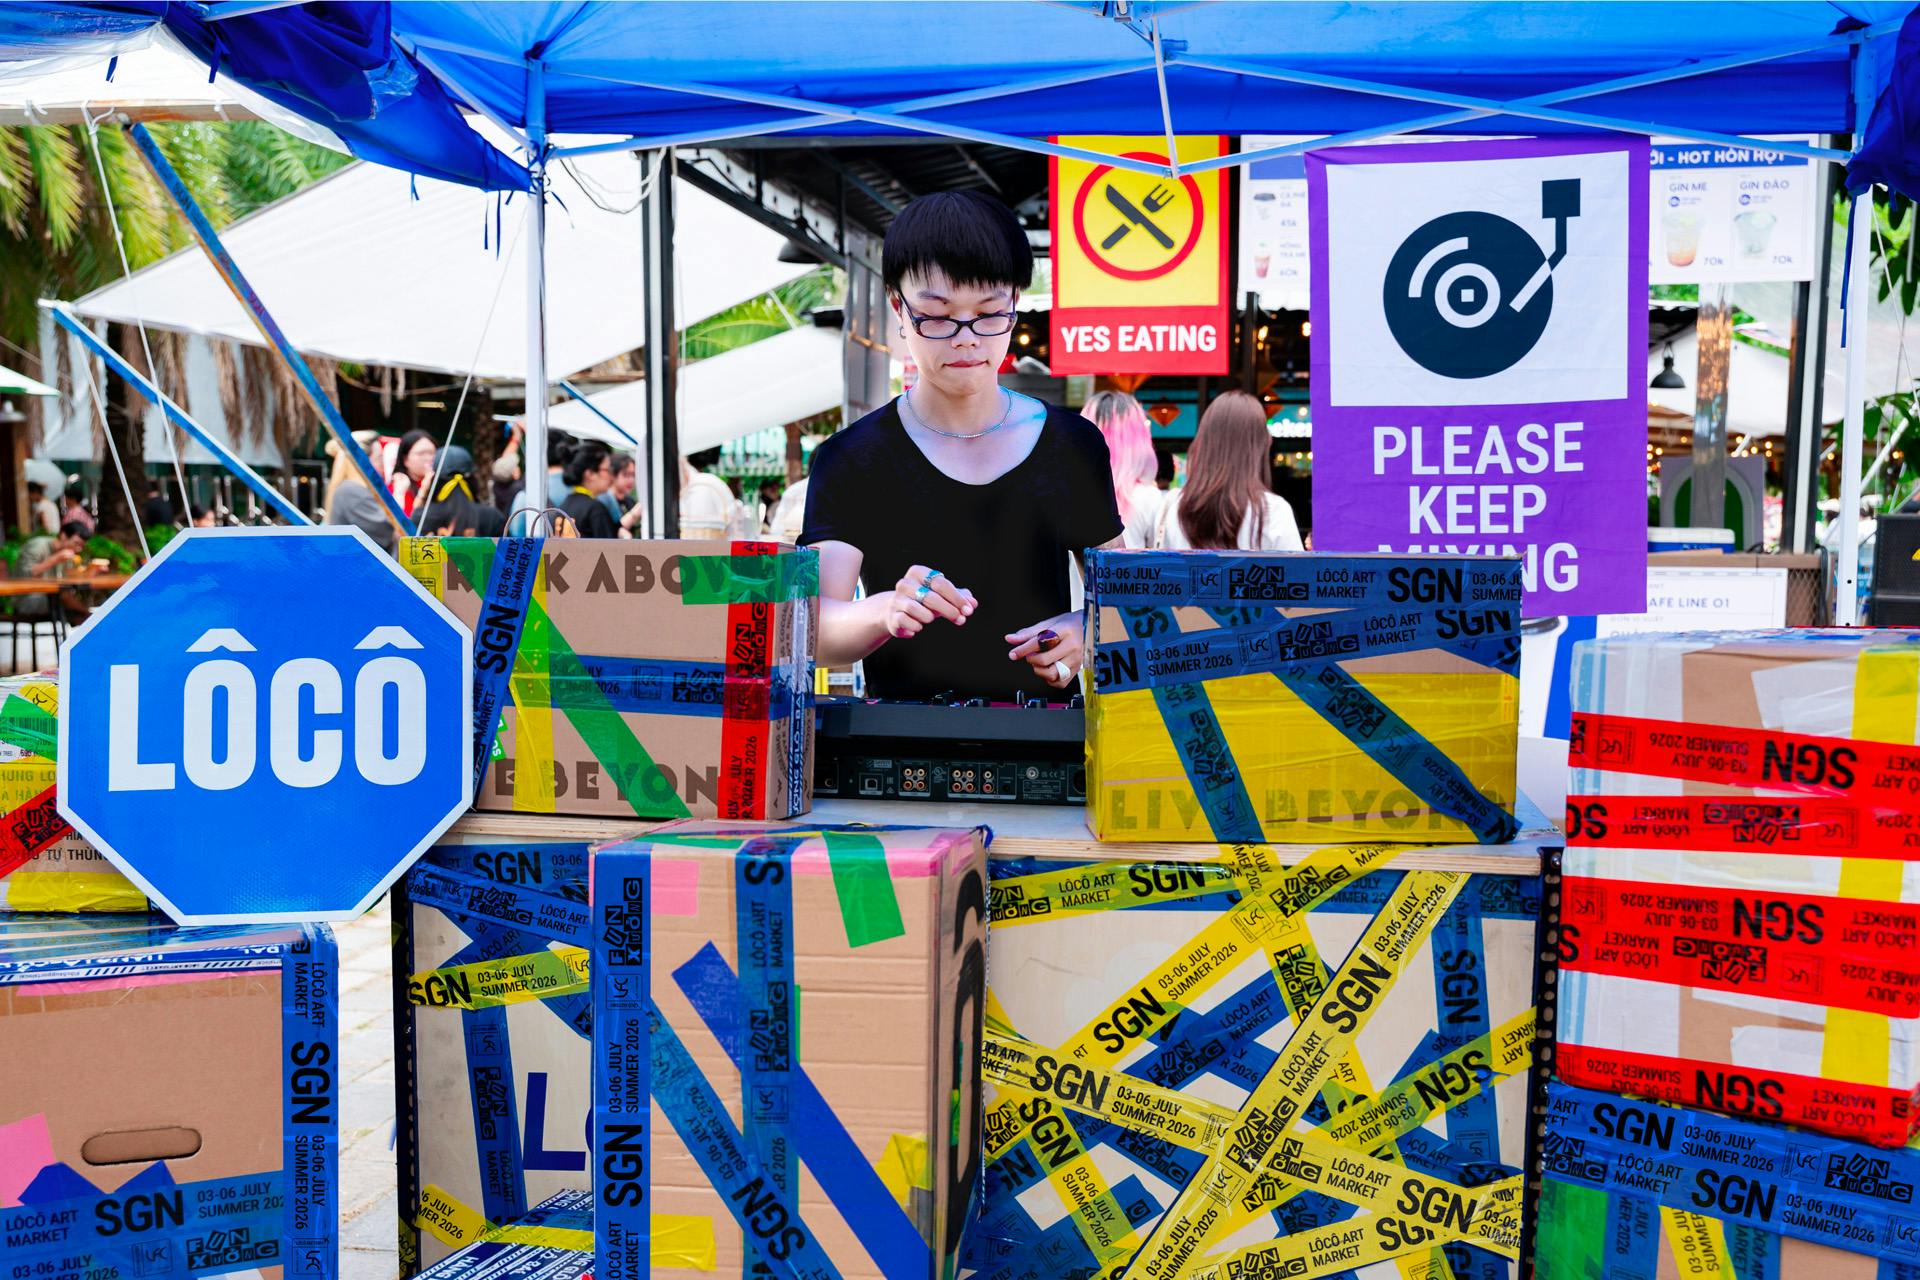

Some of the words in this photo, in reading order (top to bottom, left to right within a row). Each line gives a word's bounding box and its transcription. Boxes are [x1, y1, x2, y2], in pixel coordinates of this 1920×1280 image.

[1678, 150, 1711, 164] HOT
[1669, 183, 1689, 191] GIN
[1739, 181, 1760, 190] GIN
[1061, 325, 1110, 353] YES
[1118, 324, 1217, 353] EATING
[1373, 421, 1585, 476] PLEASE
[1407, 485, 1548, 535] KEEP
[585, 552, 728, 596] ABOV
[1097, 567, 1130, 580] 03-06
[1133, 567, 1162, 580] JULY
[1229, 564, 1285, 584] FUN
[1316, 568, 1349, 583] LÔCÔ
[1352, 571, 1376, 584] ART
[1387, 566, 1463, 604] SGN
[1097, 583, 1150, 595] SUMMER
[1152, 583, 1182, 596] 2026
[1316, 586, 1367, 599] MARKET
[1649, 598, 1674, 609] AFE
[1679, 597, 1708, 609] LINE
[1364, 613, 1397, 632] LÔCÔ
[1399, 612, 1423, 627] ART
[1435, 609, 1512, 639] SGN
[477, 603, 520, 674] SGN
[1146, 648, 1180, 662] 03-06
[1183, 641, 1210, 658] JULY
[1366, 629, 1417, 647] MARKET
[1148, 658, 1202, 677] SUMMER
[1204, 653, 1233, 668] 2026
[108, 626, 427, 791] LÔCÔ
[1649, 732, 1681, 748] 2026
[1687, 735, 1750, 755] SUMMER
[1762, 740, 1858, 790] SGN
[540, 758, 718, 805] BEYON
[1872, 773, 1905, 791] ART
[1632, 806, 1689, 821] MARKET
[67, 846, 109, 861] THÙN
[473, 851, 542, 885] SGN
[1058, 875, 1091, 894] LÔCÔ
[1093, 872, 1117, 888] ART
[1128, 860, 1206, 897] SGN
[1061, 889, 1112, 908] MARKET
[1620, 892, 1654, 909] 2026
[1656, 895, 1719, 914] SUMMER
[536, 917, 579, 936] MARKET
[1373, 918, 1403, 953] 03-06
[1397, 890, 1421, 922] JULY
[1386, 909, 1431, 963] SUMMER
[1424, 884, 1447, 913] 2026
[1644, 912, 1677, 927] JULY
[1679, 915, 1719, 931] 03-06
[1733, 898, 1824, 944] SGN
[1853, 911, 1917, 929] MARKET
[603, 905, 628, 966] FUN
[769, 911, 784, 968] MARKET
[1603, 932, 1660, 949] MARKET
[312, 962, 328, 998] LÔCÔ
[477, 970, 509, 984] 03-06
[511, 964, 535, 978] JULY
[1157, 962, 1189, 990] 03-06
[1188, 942, 1212, 968] JULY
[1167, 964, 1215, 1002] SUMMER
[1210, 942, 1239, 967] 2026
[1840, 961, 1876, 979] 2026
[295, 962, 308, 1018] MARKET
[408, 972, 473, 1006] SGN
[480, 978, 529, 997] SUMMER
[531, 975, 558, 989] 2026
[1321, 953, 1392, 1034] SGN
[1439, 950, 1481, 1025] SGN
[312, 1001, 325, 1028] ART
[1093, 987, 1168, 1054] SGN
[626, 1018, 640, 1051] 2026
[608, 1041, 622, 1072] JULY
[1587, 1060, 1619, 1076] 2026
[291, 1041, 330, 1124] SGN
[626, 1053, 640, 1113] SUMMER
[1030, 1055, 1110, 1112] SGN
[1291, 1049, 1331, 1098] MARKET
[1413, 1050, 1493, 1112] SGN
[1621, 1064, 1681, 1084] SUMMER
[608, 1076, 622, 1113] 03-06
[1116, 1085, 1151, 1107] 03-06
[1151, 1097, 1183, 1117] JULY
[1358, 1093, 1409, 1125] SUMMER
[1696, 1070, 1785, 1119] SGN
[1811, 1088, 1876, 1109] MARKET
[1019, 1097, 1081, 1169] SGN
[1111, 1100, 1164, 1132] SUMMER
[1165, 1119, 1197, 1139] 2026
[1329, 1119, 1359, 1142] 2026
[1589, 1102, 1675, 1151] SGN
[1684, 1124, 1721, 1143] 03-06
[1723, 1132, 1757, 1151] JULY
[295, 1135, 308, 1195] SUMMER
[312, 1135, 325, 1173] 03-06
[603, 1124, 643, 1208] SGN
[1617, 1152, 1654, 1173] LÔCÔ
[1655, 1162, 1683, 1180] ART
[1681, 1140, 1739, 1165] SUMMER
[1741, 1153, 1775, 1172] 2026
[1828, 1153, 1891, 1180] FUN
[1326, 1173, 1380, 1200] MARKET
[1331, 1156, 1365, 1179] LÔCÔ
[1365, 1169, 1392, 1188] ART
[1613, 1169, 1671, 1195] MARKET
[197, 1187, 236, 1203] 03-06
[240, 1182, 271, 1198] JULY
[312, 1177, 325, 1207] JULY
[1074, 1166, 1099, 1198] 03-06
[1092, 1194, 1116, 1224] JULY
[1397, 1179, 1478, 1234] SGN
[1691, 1168, 1777, 1222] SGN
[1786, 1193, 1823, 1214] 03-06
[1826, 1203, 1858, 1221] JULY
[5, 1211, 46, 1232] LÔCÔ
[50, 1209, 79, 1226] ART
[94, 1189, 184, 1237] SGN
[295, 1199, 308, 1230] 2026
[731, 1176, 805, 1261] SGN
[1062, 1172, 1094, 1222] SUMMER
[1089, 1217, 1111, 1248] 2026
[1196, 1208, 1219, 1237] 2026
[7, 1227, 70, 1248] MARKET
[186, 1227, 250, 1255] FUN
[608, 1220, 622, 1246] ART
[1308, 1233, 1342, 1253] LÔCÔ
[1341, 1228, 1365, 1246] ART
[1783, 1210, 1841, 1236] SUMMER
[1842, 1224, 1875, 1243] 2026
[1145, 1245, 1174, 1277] 03-06
[1170, 1215, 1193, 1244] JULY
[1312, 1244, 1361, 1268] MARKET
[12, 1261, 55, 1280] 03-06
[59, 1254, 92, 1272] JULY
